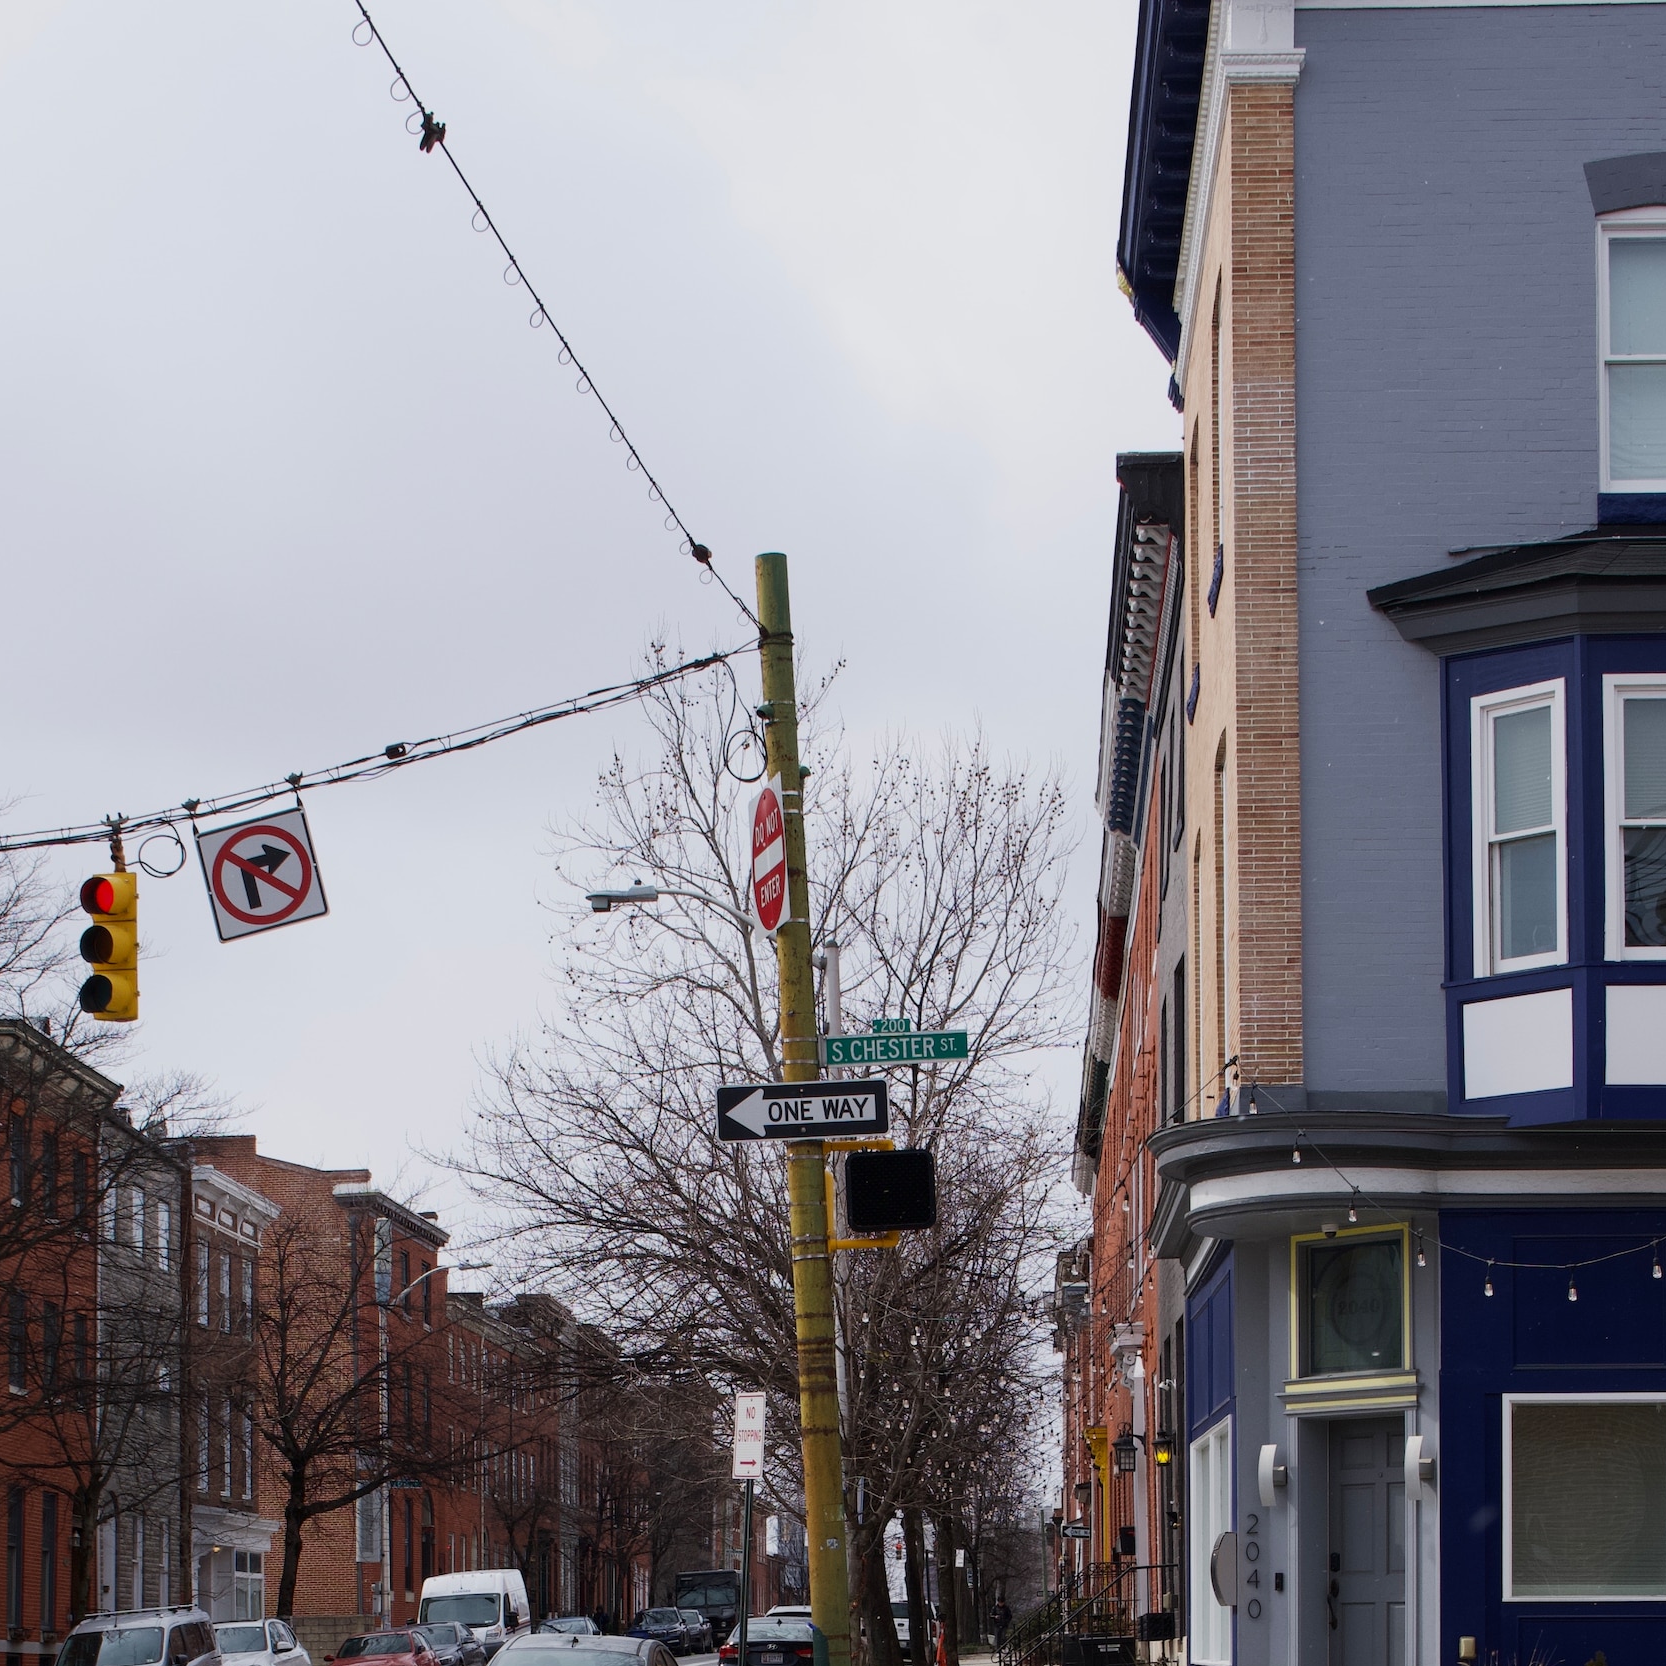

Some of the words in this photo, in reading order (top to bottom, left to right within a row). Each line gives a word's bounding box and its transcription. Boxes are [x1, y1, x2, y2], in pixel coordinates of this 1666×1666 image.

[755, 823, 765, 847] DO
[766, 809, 778, 837] NOT
[760, 874, 781, 908] ENTER
[881, 1020, 907, 1033] 200
[832, 1041, 848, 1062] S.
[850, 1037, 935, 1060] CHESTER
[940, 1036, 958, 1052] ST.
[768, 1100, 813, 1122] ONE
[822, 1097, 869, 1119] WAY
[746, 1407, 756, 1419] NO
[738, 1429, 761, 1442] STOPPING
